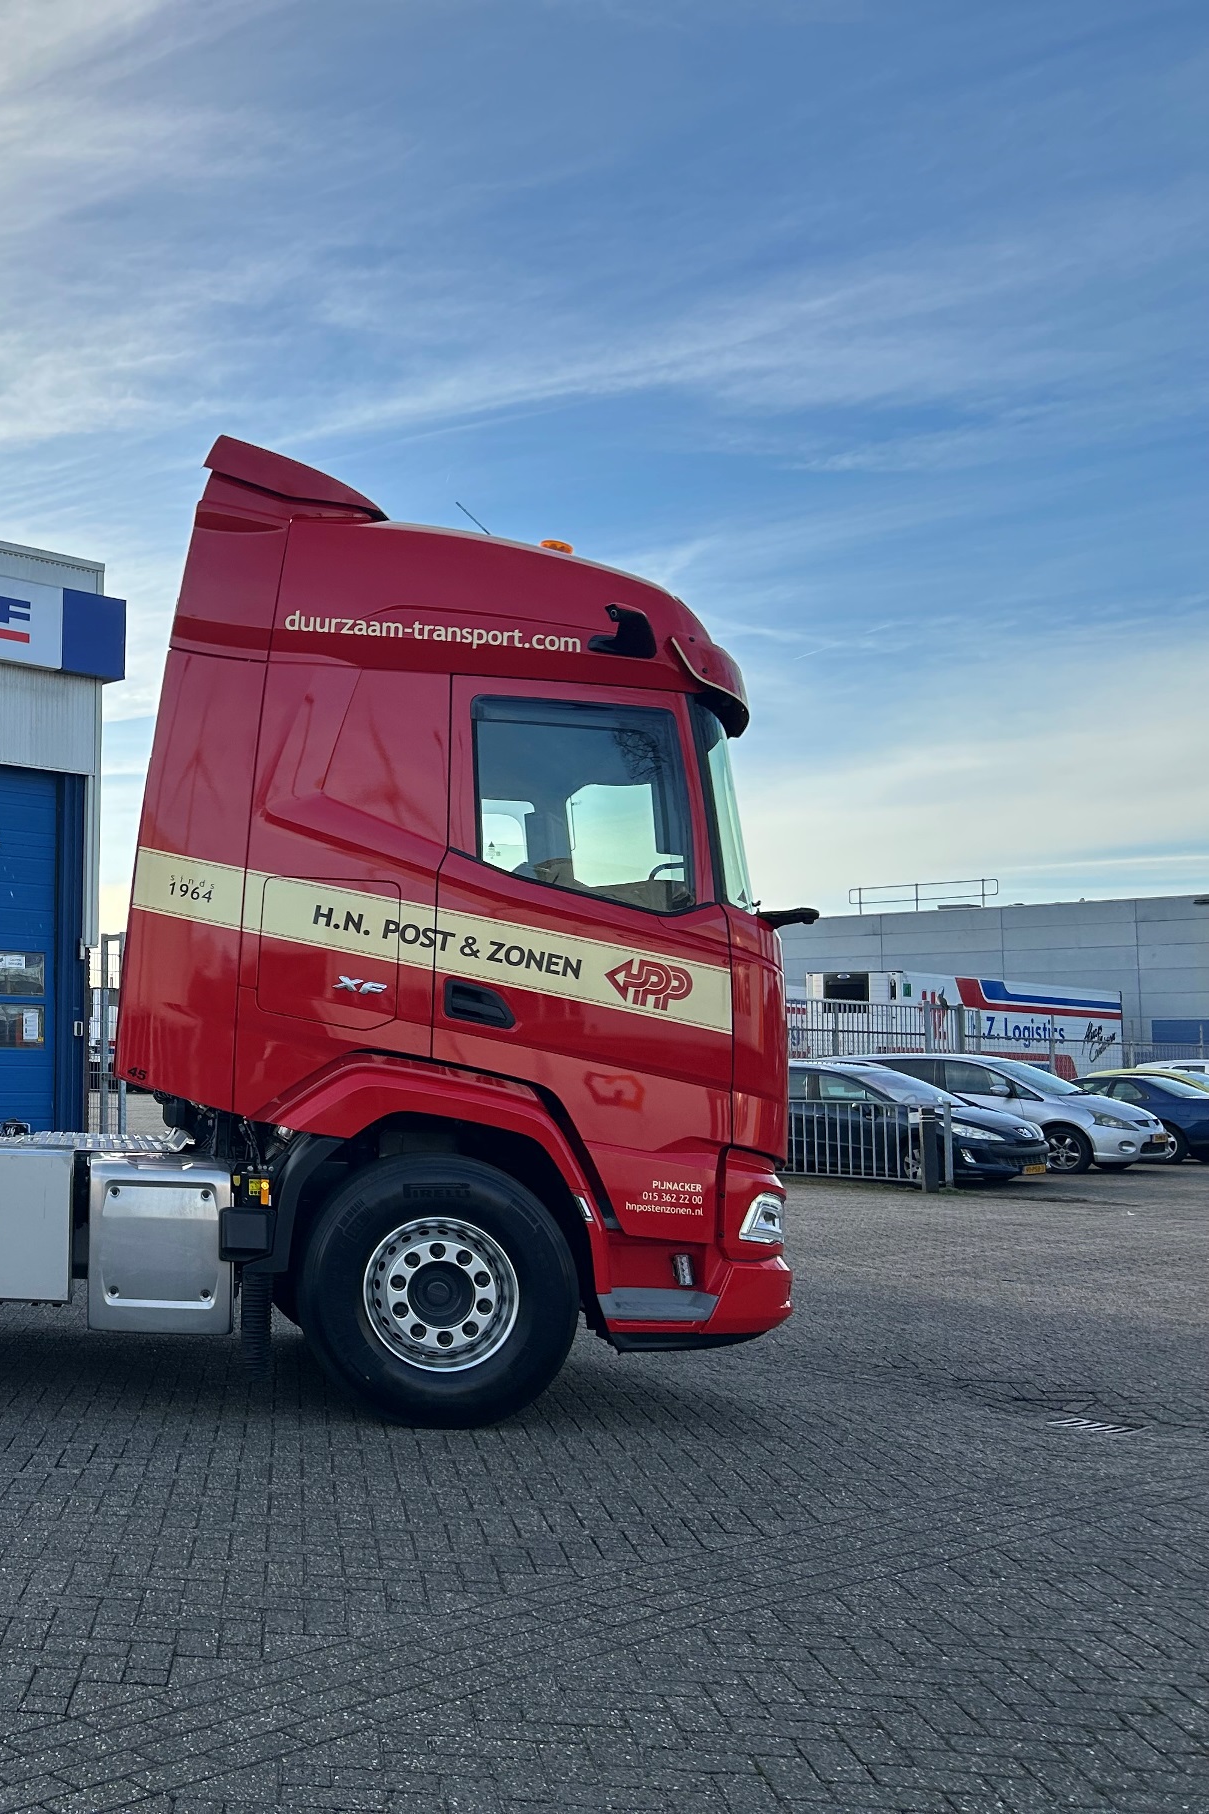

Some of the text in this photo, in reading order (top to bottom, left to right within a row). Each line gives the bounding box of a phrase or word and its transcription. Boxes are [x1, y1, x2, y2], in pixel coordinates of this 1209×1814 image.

[284, 610, 581, 653] duurzaam-transport.com
[169, 881, 213, 904] 1964
[312, 904, 583, 980] H.N. POST & ZONEN
[332, 975, 388, 995] XF
[127, 1067, 148, 1081] 45
[403, 1182, 471, 1199] PIRELLI
[652, 1180, 703, 1193] PIJNACKER
[642, 1191, 704, 1205] 015 362 22 00
[625, 1201, 704, 1216] hnpostenzonen.nl
